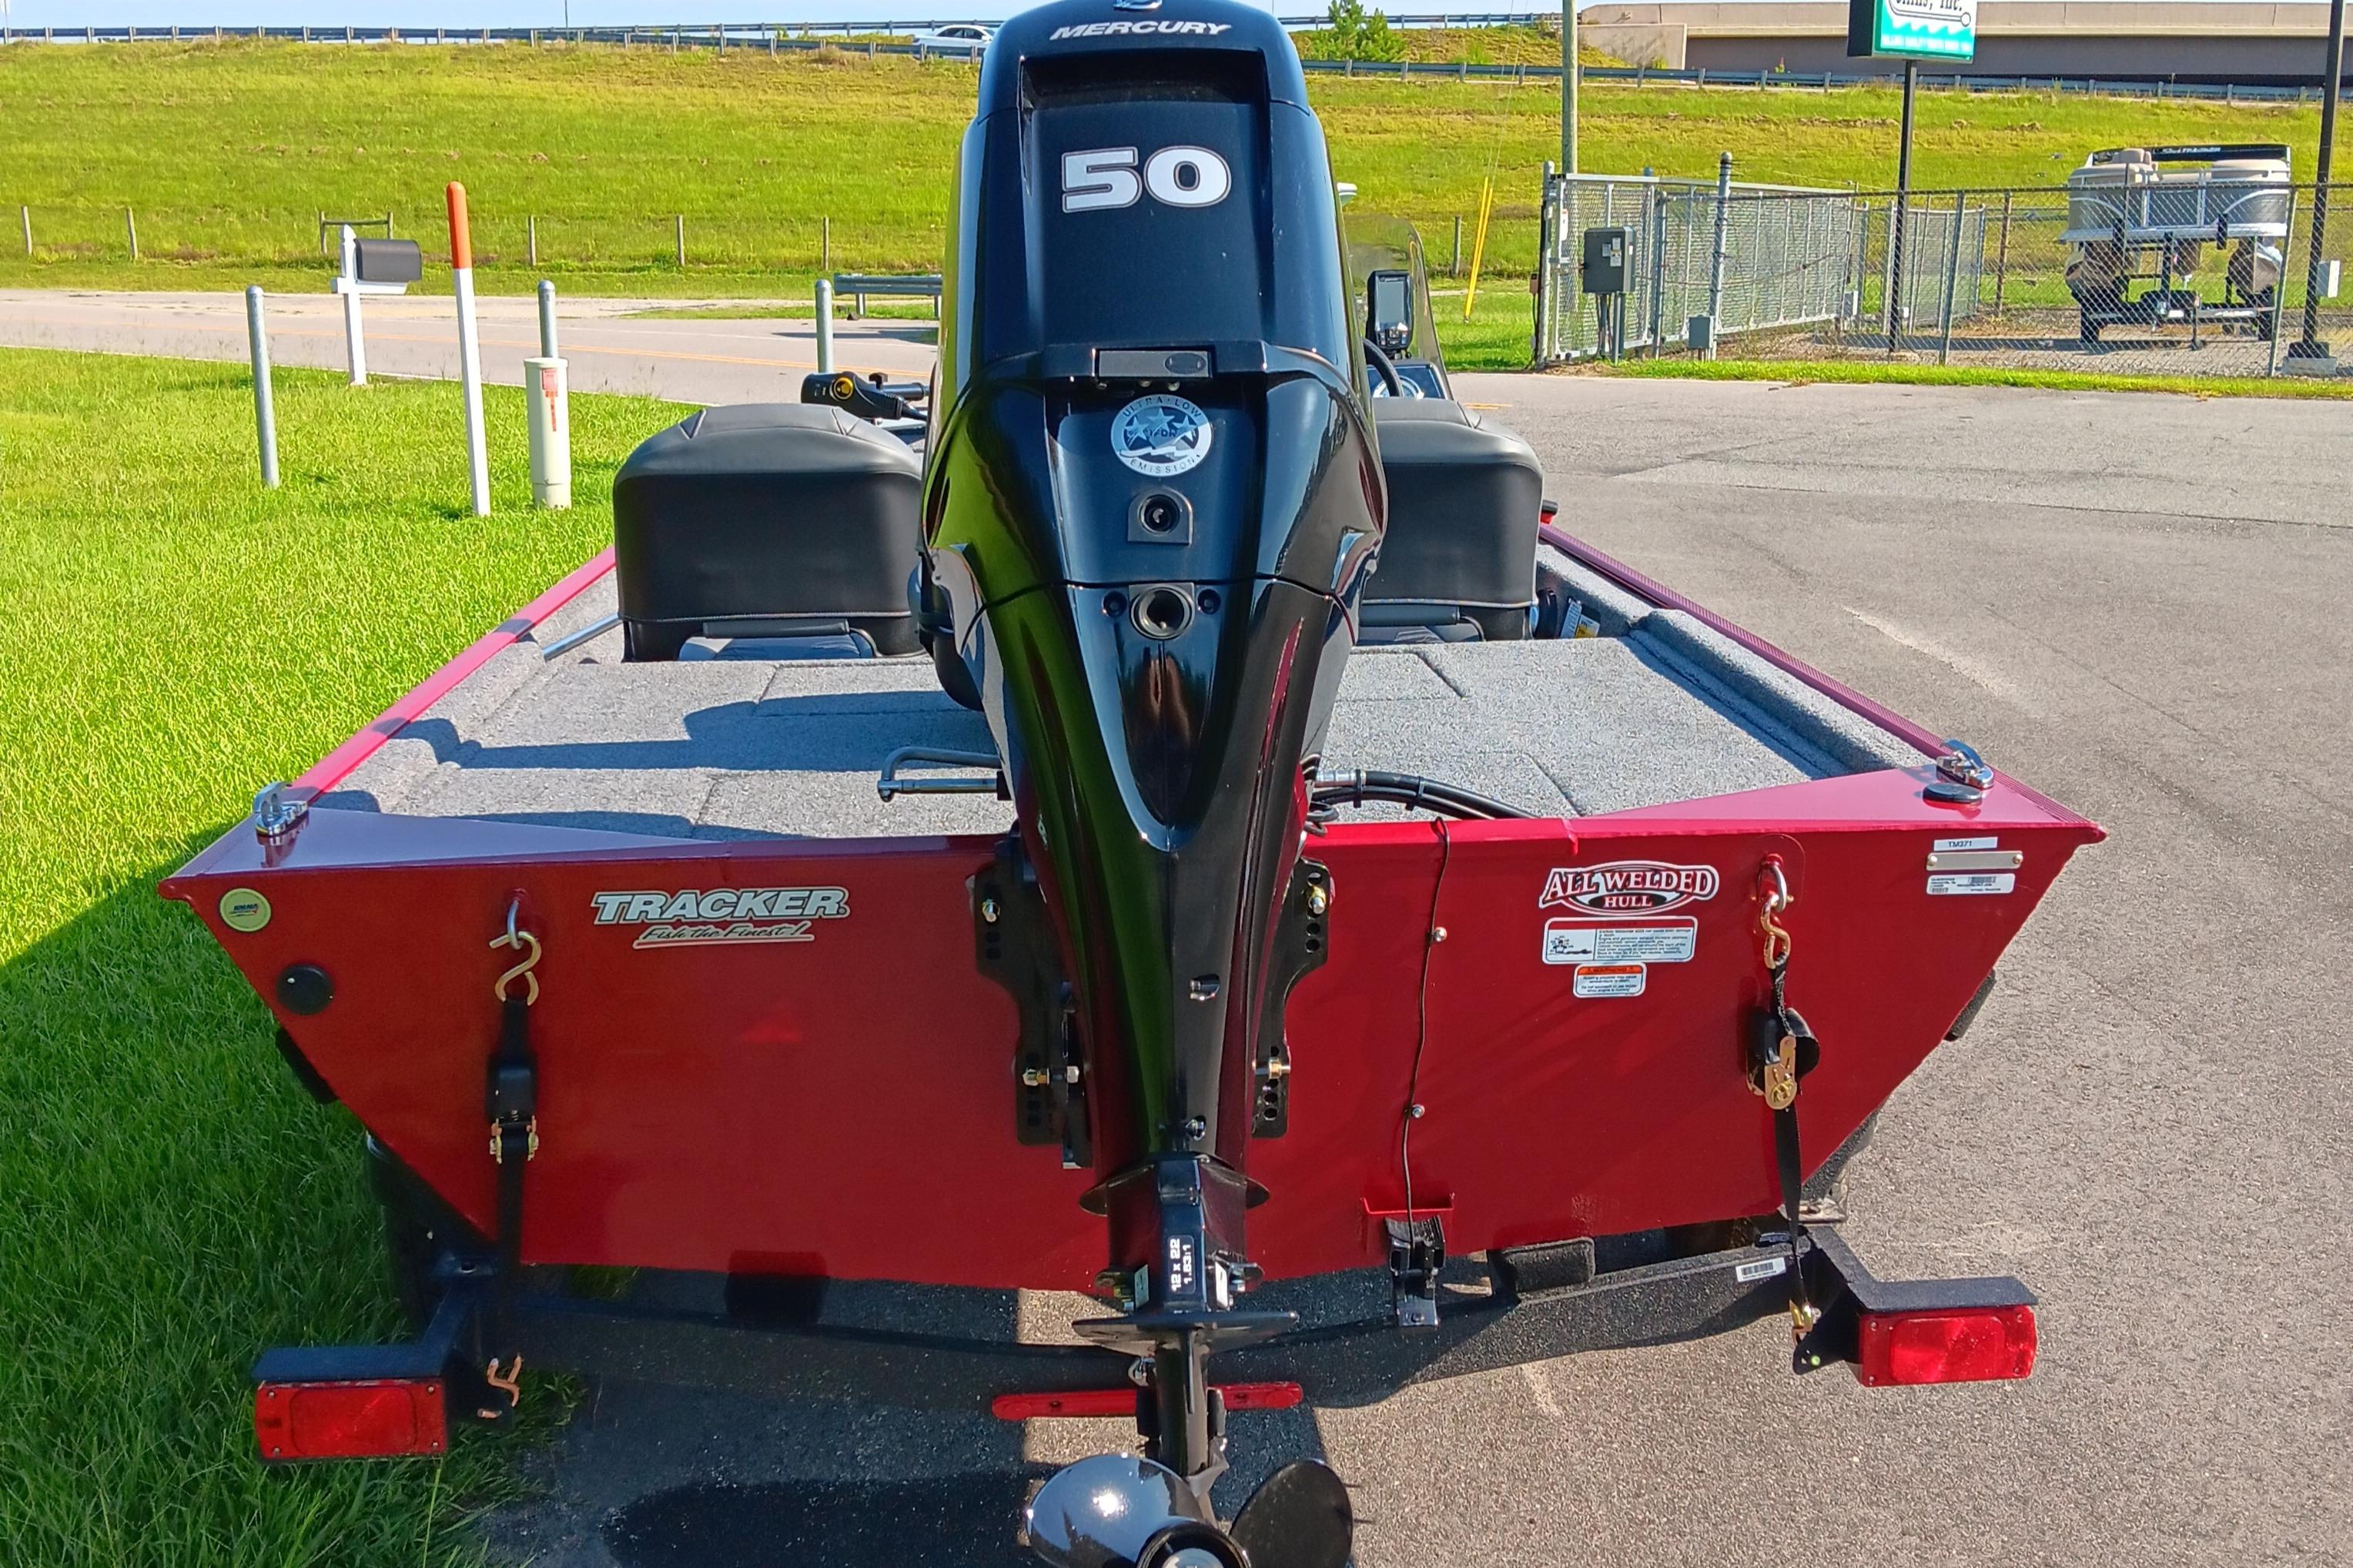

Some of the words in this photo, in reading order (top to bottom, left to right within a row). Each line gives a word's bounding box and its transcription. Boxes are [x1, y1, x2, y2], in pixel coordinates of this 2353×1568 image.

[1049, 21, 1232, 39] MERCURY
[1062, 145, 1232, 214] 50
[1123, 396, 1163, 417] ULTRA
[1175, 398, 1201, 418] LOW
[1130, 456, 1195, 474] EMISSION
[1543, 871, 1598, 901] ALL
[1601, 870, 1714, 896] WELDED
[593, 888, 848, 923] TRACKER
[1603, 894, 1652, 908] HULL
[642, 927, 686, 940] Fish
[690, 927, 720, 938] the
[1170, 1238, 1180, 1259] 22
[1170, 1274, 1181, 1292] 12
